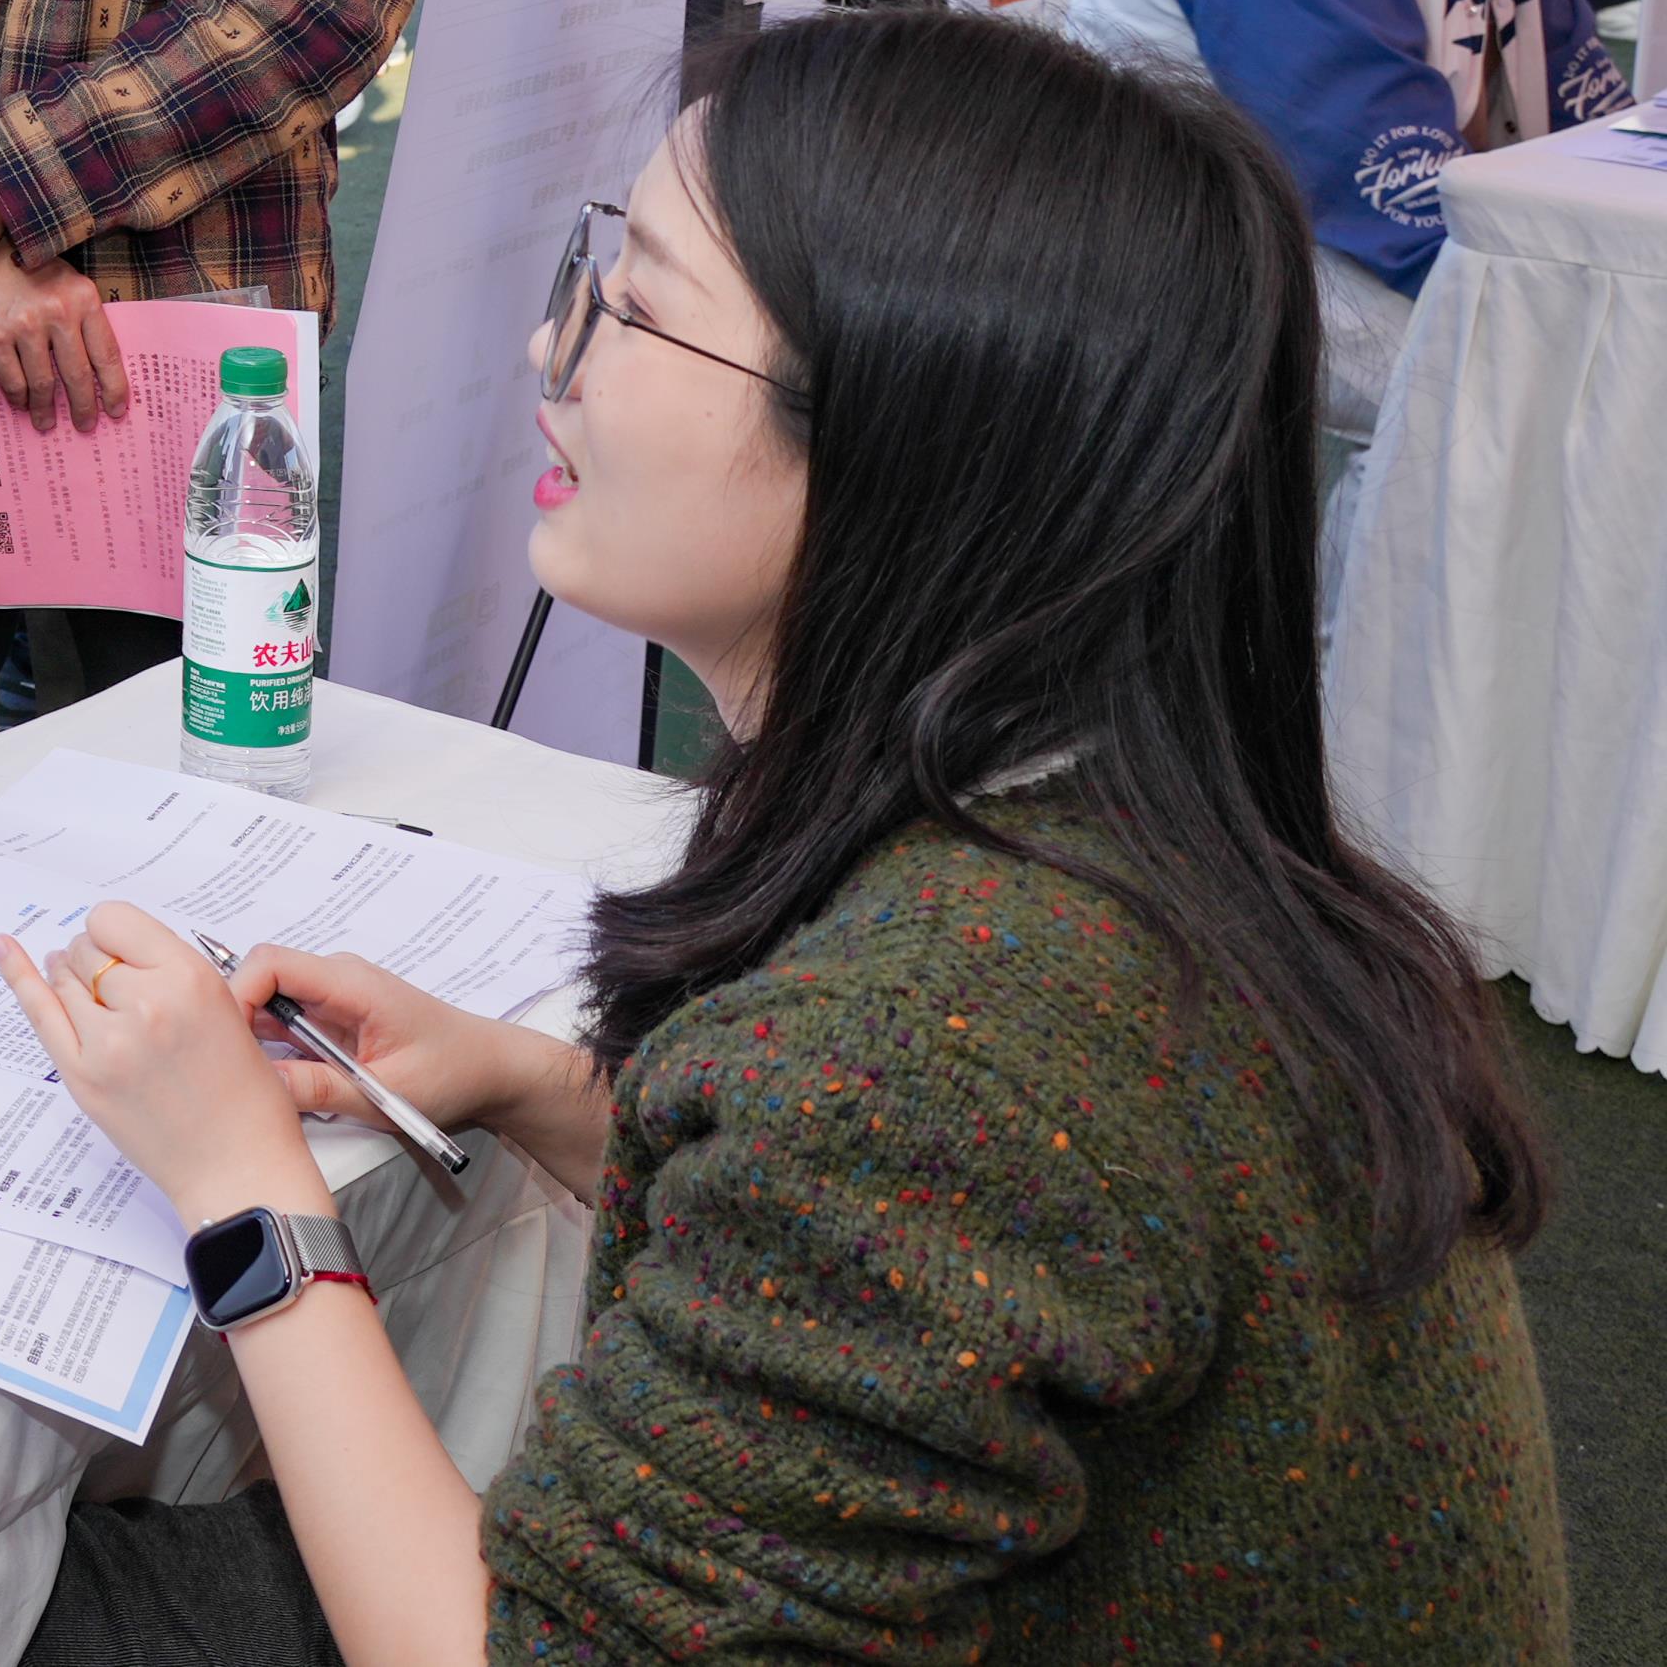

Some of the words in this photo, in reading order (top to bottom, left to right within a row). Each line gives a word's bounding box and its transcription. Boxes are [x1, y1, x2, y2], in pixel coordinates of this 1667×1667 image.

[253, 634, 315, 667] 农夫山
[250, 678, 286, 687] PURIFIED
[24, 1331, 51, 1366] 自我评价
